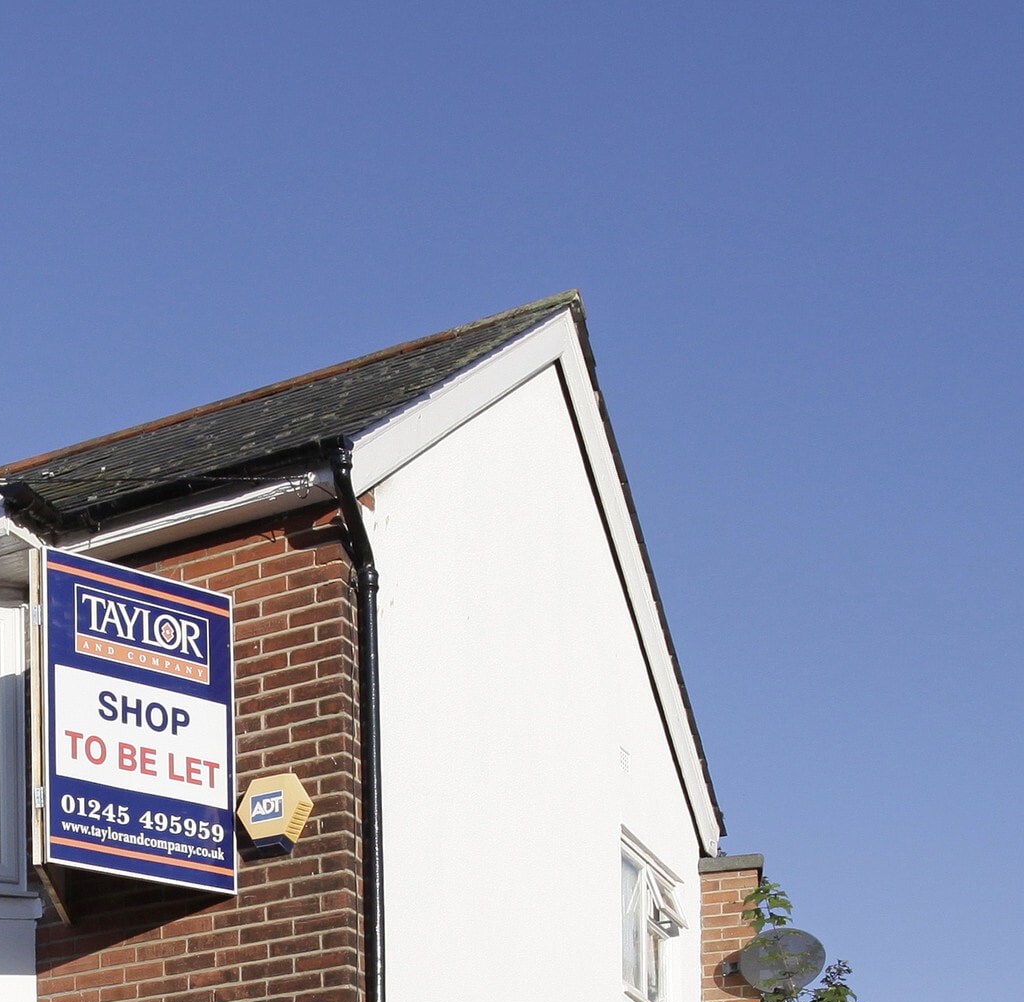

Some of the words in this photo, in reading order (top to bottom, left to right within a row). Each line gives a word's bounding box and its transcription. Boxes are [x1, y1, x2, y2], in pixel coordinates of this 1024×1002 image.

[81, 593, 205, 659] TAYLOR
[83, 641, 116, 655] AND
[127, 651, 204, 678] COMPANY
[98, 690, 190, 735] SHOP
[64, 730, 107, 765] TO
[118, 742, 158, 776] BE
[168, 752, 220, 788] LET
[60, 793, 130, 825] 01245
[138, 810, 225, 843] 495959
[251, 796, 282, 818] ADT
[61, 820, 225, 861] www.taylorandcompany.co.uk
